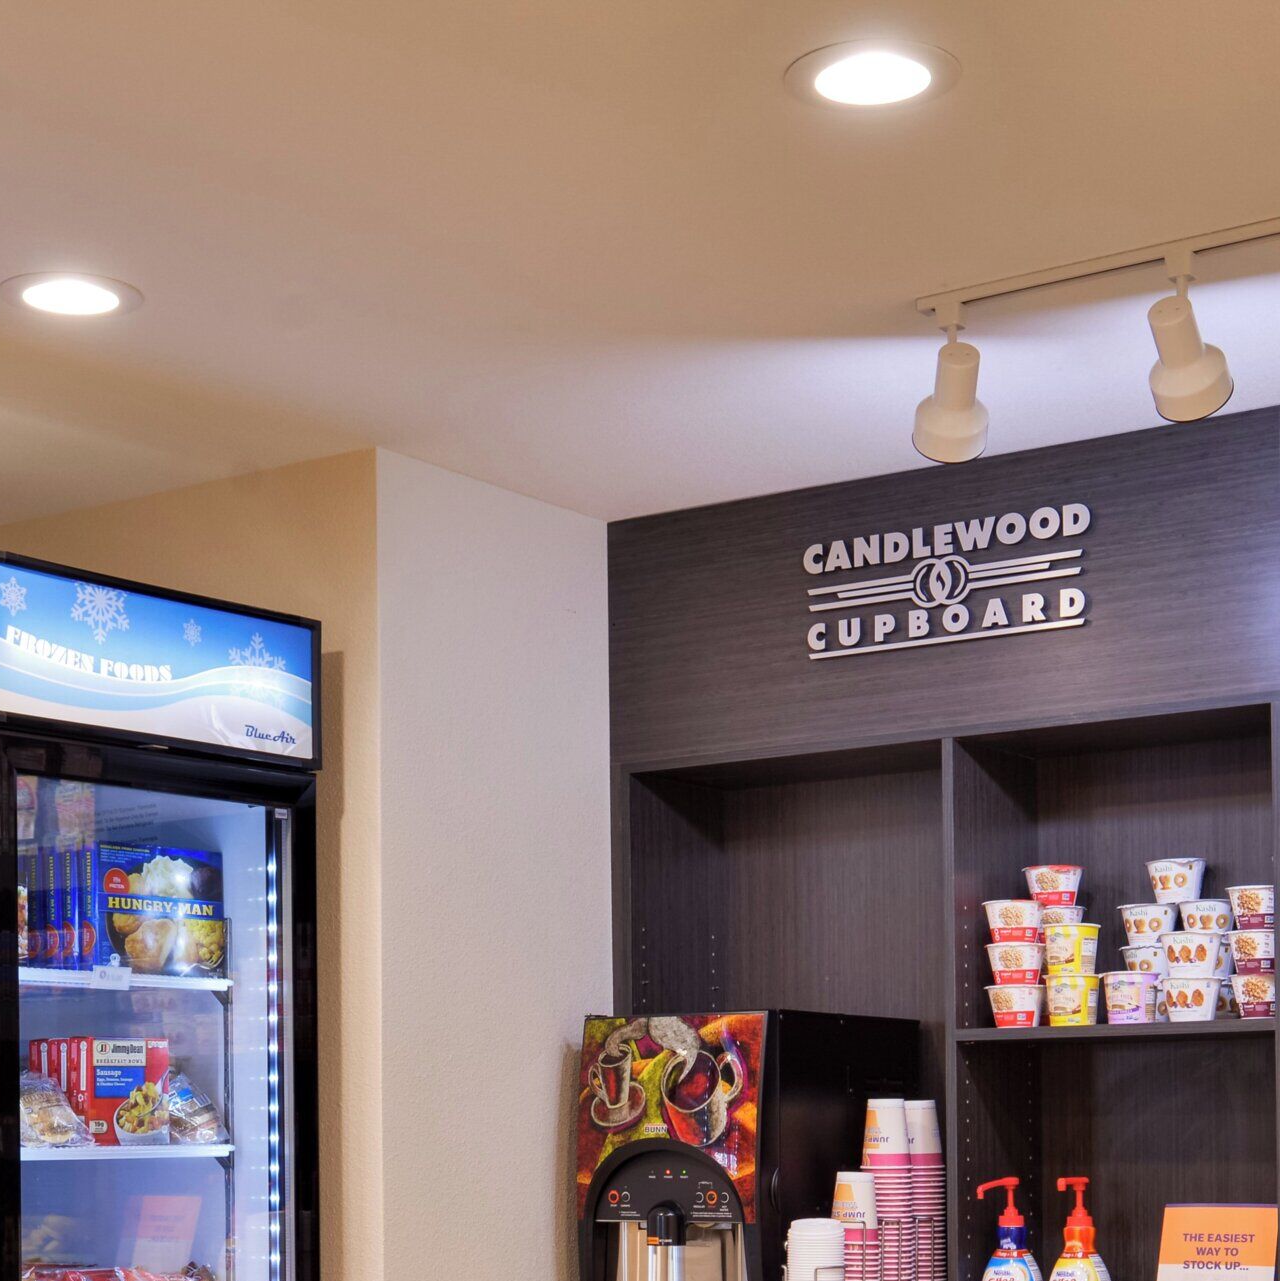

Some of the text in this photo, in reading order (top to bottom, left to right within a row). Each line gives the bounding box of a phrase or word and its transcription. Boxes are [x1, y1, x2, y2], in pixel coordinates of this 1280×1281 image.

[802, 503, 1092, 575] CANDLEWOOD
[807, 587, 1086, 651] CUPBOARD
[6, 625, 173, 684] FROZEN FOODS
[108, 897, 215, 916] HUNGRY-MAN
[96, 1069, 122, 1077] Sausage
[843, 1211, 866, 1220] JUMP
[1183, 1233, 1255, 1243] THE EASIEST
[1196, 1247, 1239, 1256] WAY TO
[1183, 1260, 1249, 1271] STOCK UP...
